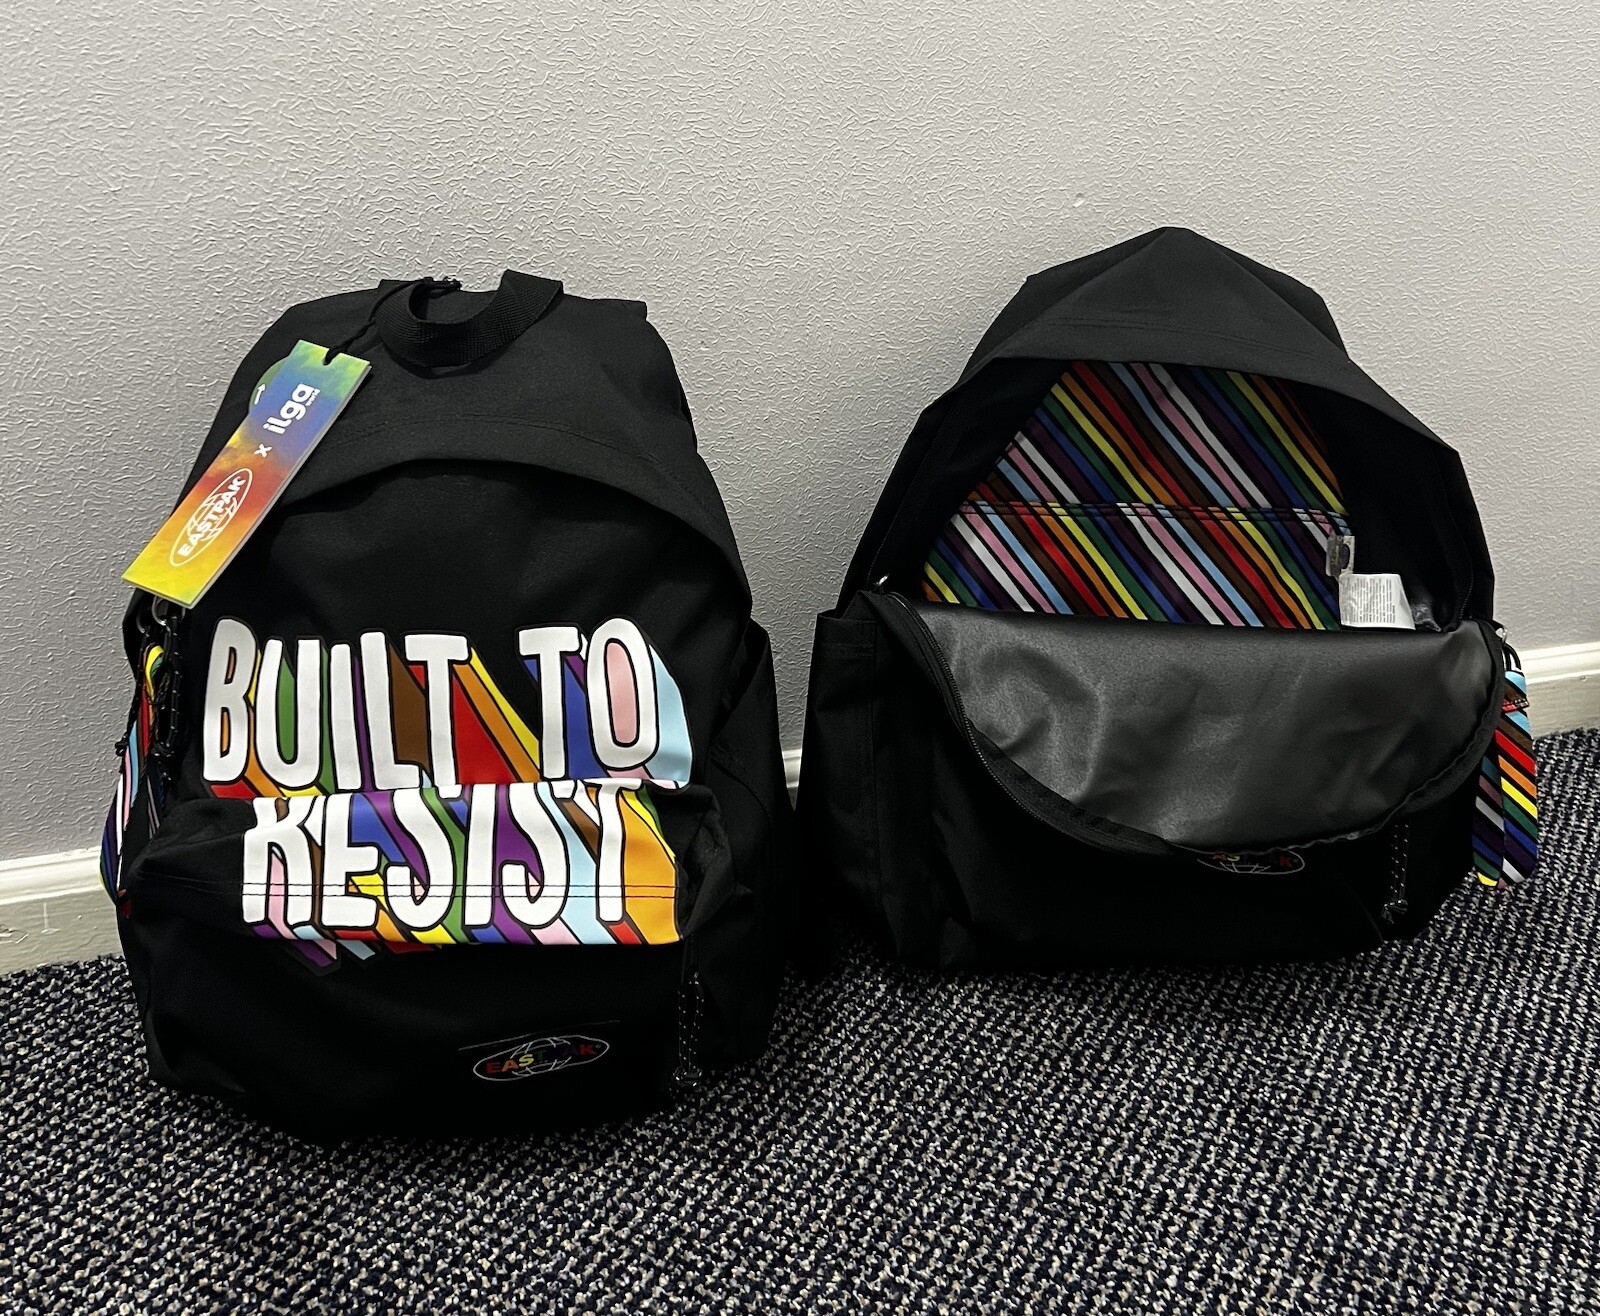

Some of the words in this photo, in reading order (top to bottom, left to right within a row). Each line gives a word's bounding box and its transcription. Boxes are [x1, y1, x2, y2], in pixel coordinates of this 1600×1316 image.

[178, 475, 247, 557] EASTPAK
[262, 383, 315, 435] ilga
[202, 617, 470, 791] BUILT
[518, 617, 660, 781] TO
[241, 777, 642, 928] RESIST
[485, 1043, 598, 1075] EASTAK
